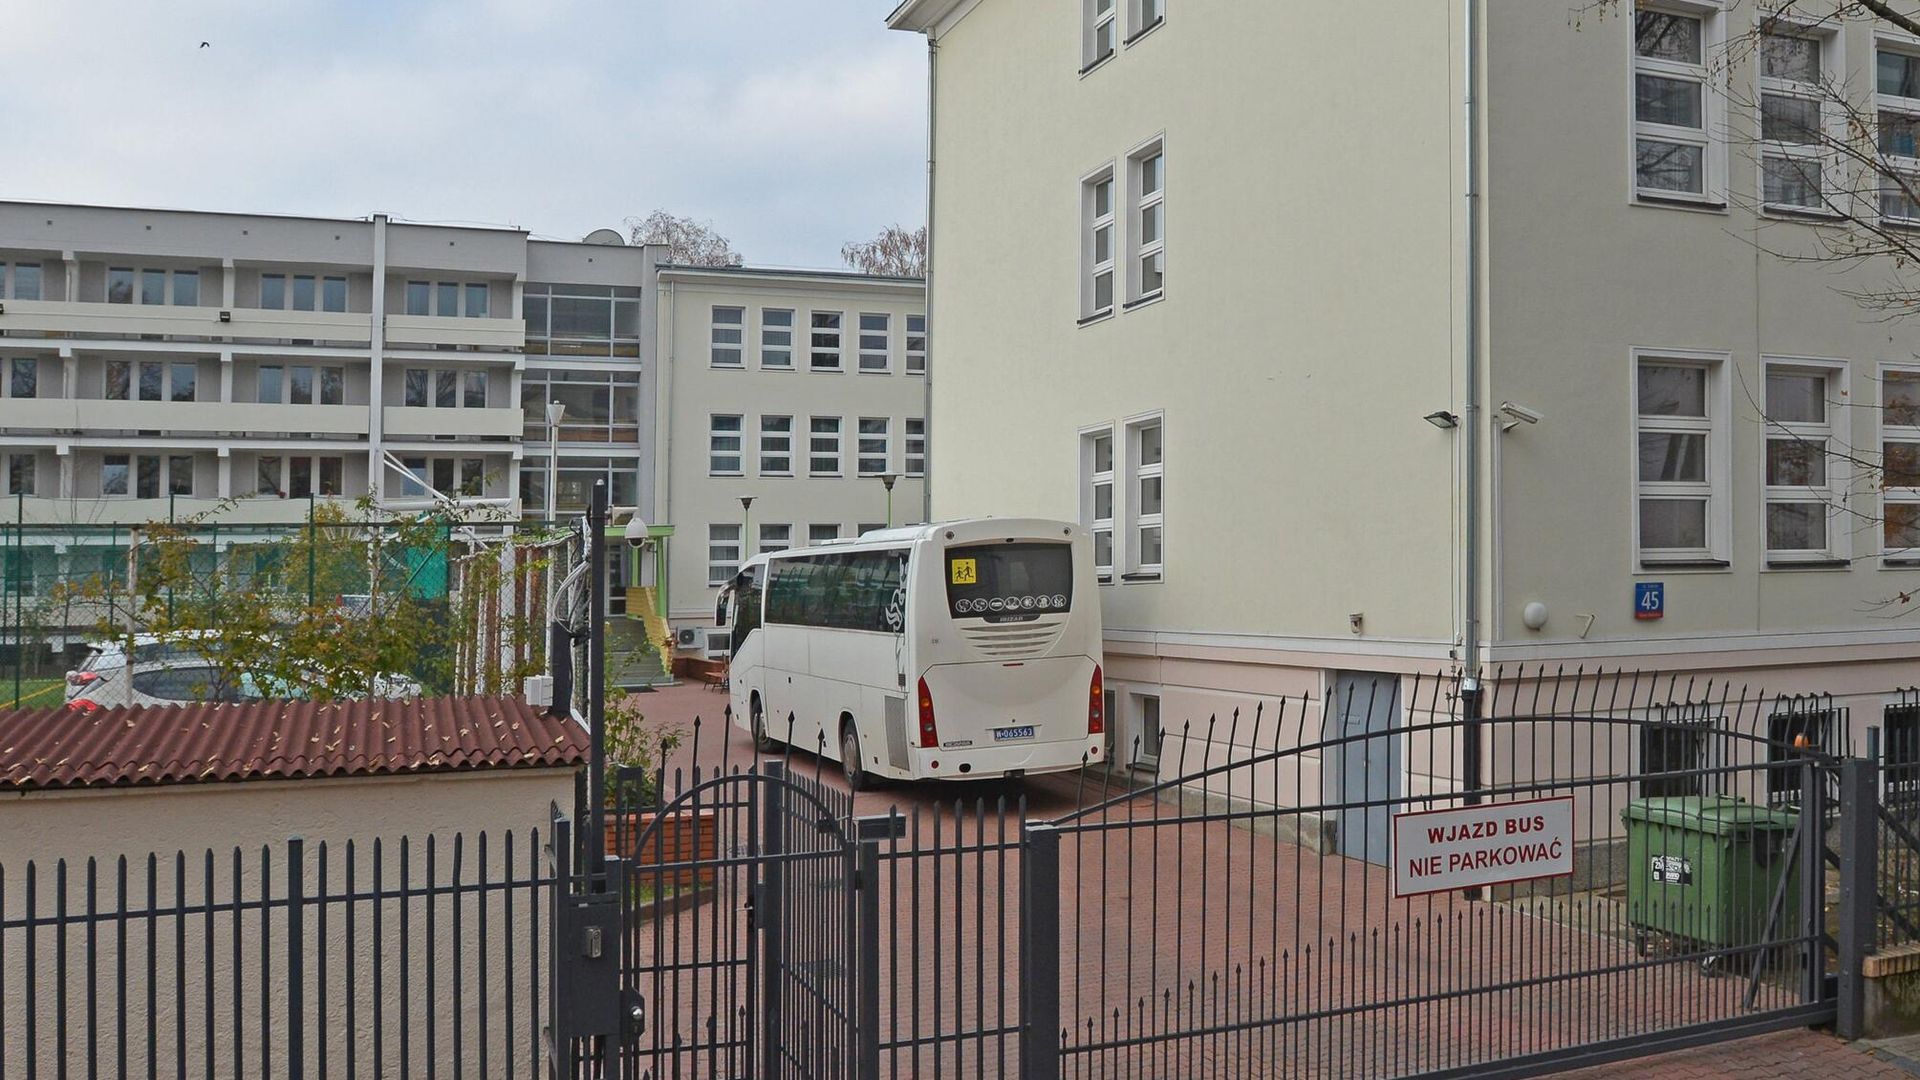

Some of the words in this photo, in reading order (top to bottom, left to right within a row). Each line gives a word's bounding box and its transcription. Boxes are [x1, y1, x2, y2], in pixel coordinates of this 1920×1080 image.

[1641, 592, 1659, 610] 45
[1427, 820, 1498, 844] WJAZD
[1505, 815, 1545, 835] BUS
[1409, 855, 1442, 878] NIE
[1449, 836, 1562, 872] PARKOWAĆ
